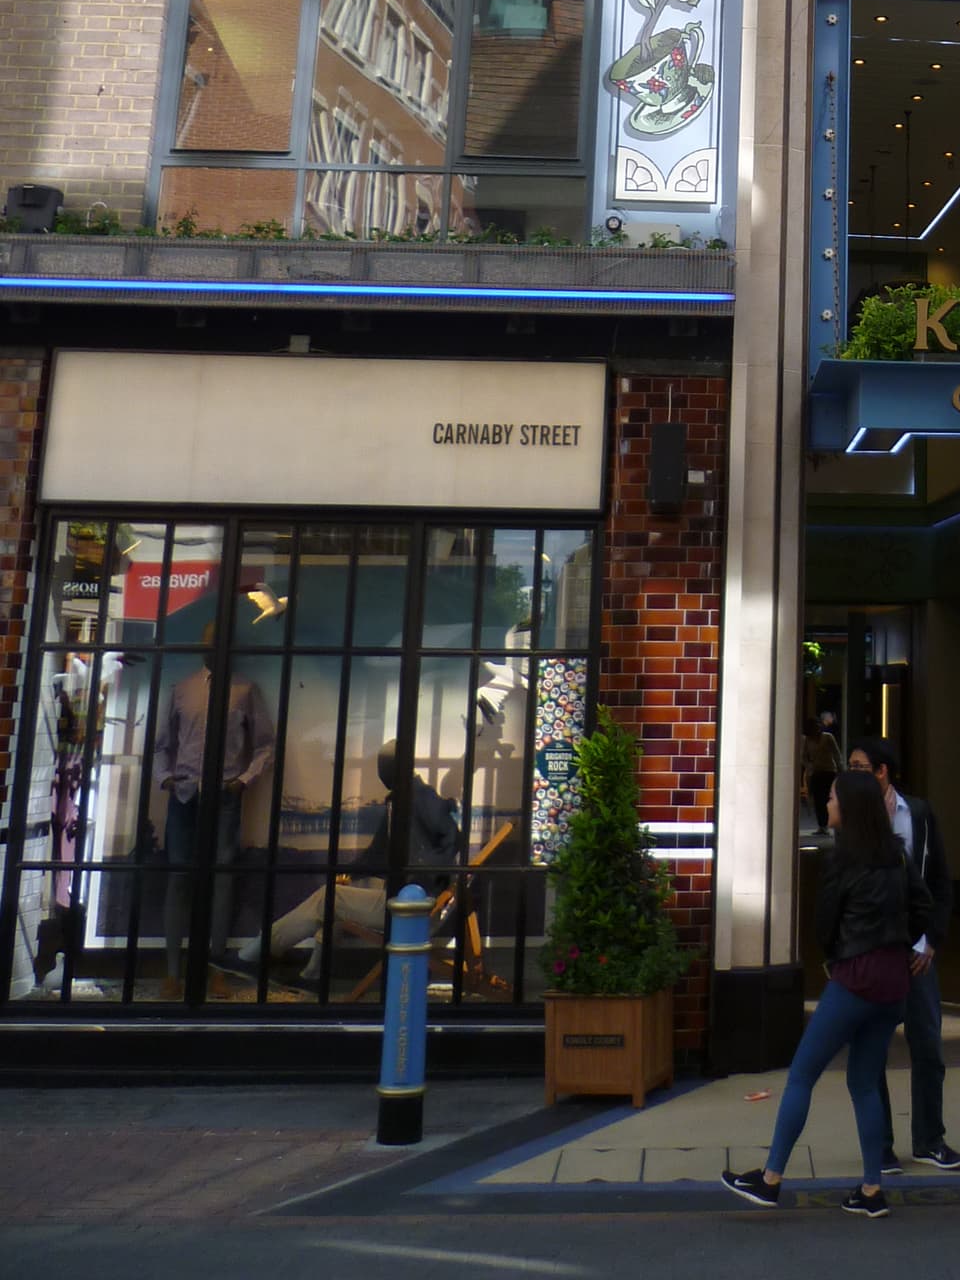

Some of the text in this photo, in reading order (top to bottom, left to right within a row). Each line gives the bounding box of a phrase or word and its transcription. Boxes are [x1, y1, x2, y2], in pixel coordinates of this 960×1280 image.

[432, 422, 581, 446] CARNABY STREET
[547, 760, 569, 772] ROCK
